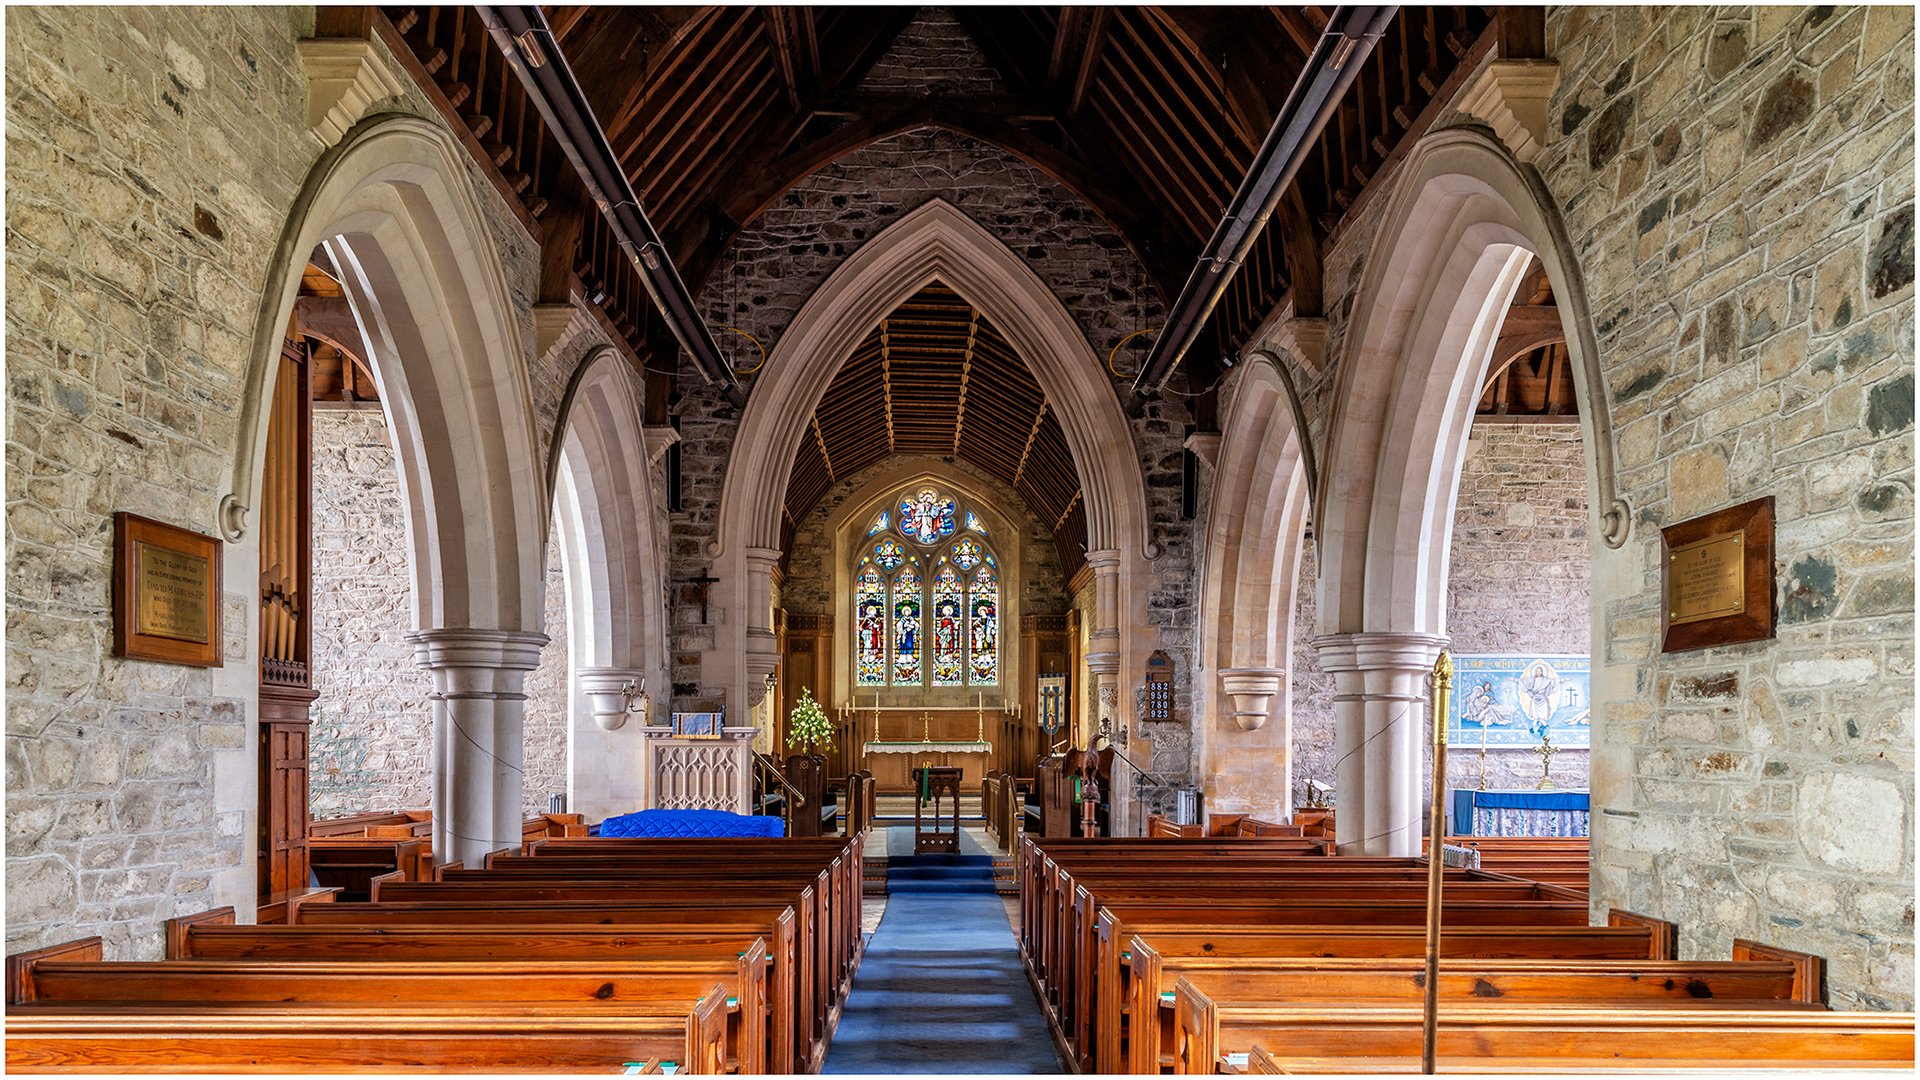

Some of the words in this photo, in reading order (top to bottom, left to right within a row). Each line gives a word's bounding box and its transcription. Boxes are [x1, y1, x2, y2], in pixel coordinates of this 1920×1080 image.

[147, 580, 167, 593] DAVID
[1150, 683, 1168, 691] 882
[1150, 691, 1168, 700] 956
[1150, 701, 1168, 709] 780
[1150, 710, 1168, 718] 923
